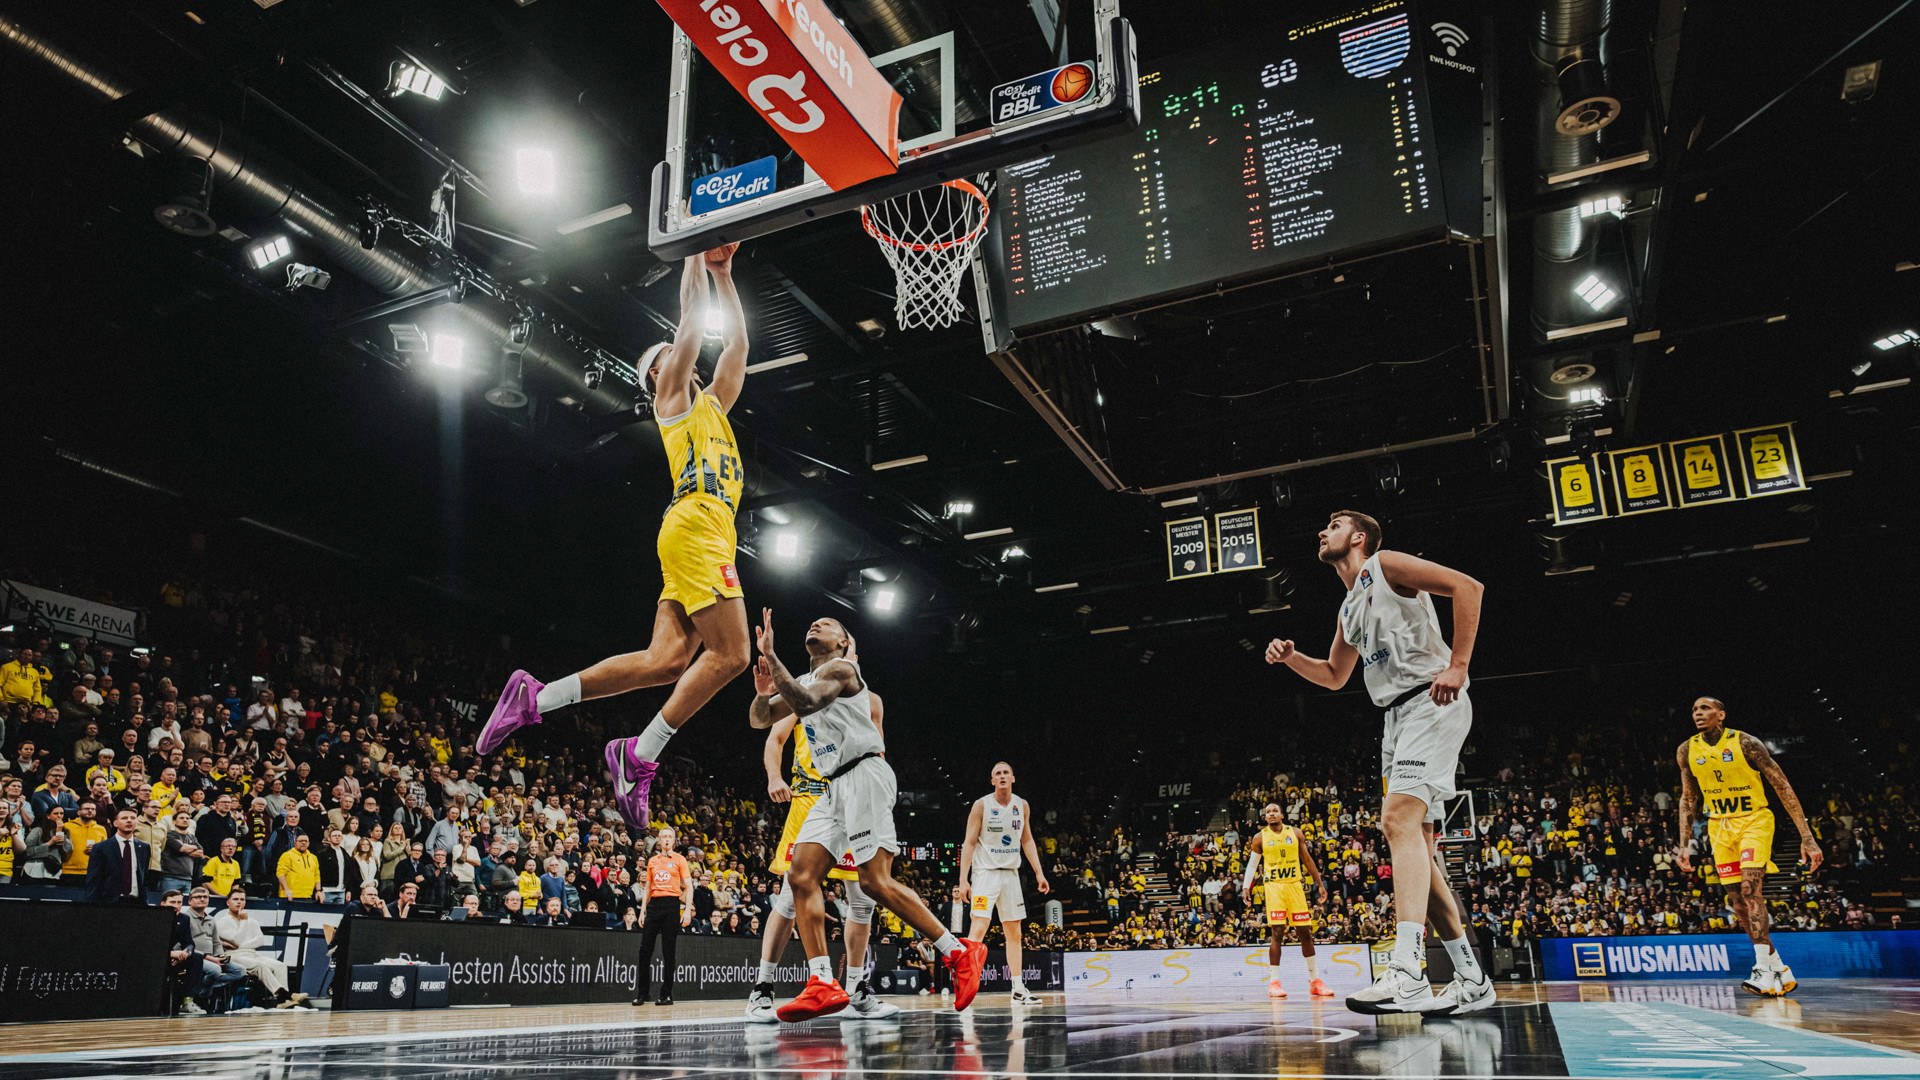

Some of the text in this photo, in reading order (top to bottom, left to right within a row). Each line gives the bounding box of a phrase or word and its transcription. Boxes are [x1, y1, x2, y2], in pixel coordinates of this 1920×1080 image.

[1430, 55, 1475, 73] EWE HOTSPOT
[1164, 81, 1219, 117] 9:11
[999, 96, 1041, 120] BBL
[1754, 448, 1782, 464] 23
[1688, 458, 1714, 474] 14
[1633, 469, 1646, 483] 8
[1570, 478, 1582, 491] 6
[1221, 515, 1253, 525] DEUTSCHER
[1221, 521, 1253, 530] POKALSIEGER
[1171, 523, 1202, 533] DEUTSCHER
[1176, 530, 1199, 538] MEISTER
[1221, 533, 1254, 548] 2015
[1173, 541, 1204, 556] 2009
[80, 612, 132, 636] ARENA
[1713, 770, 1724, 782] 12
[1159, 783, 1191, 797] EWE
[1271, 866, 1296, 879] EWE
[1607, 944, 1730, 973] HUSMANN
[509, 955, 566, 984] Assists
[571, 957, 591, 983] im
[595, 956, 637, 991] Alltag
[674, 962, 696, 983] em
